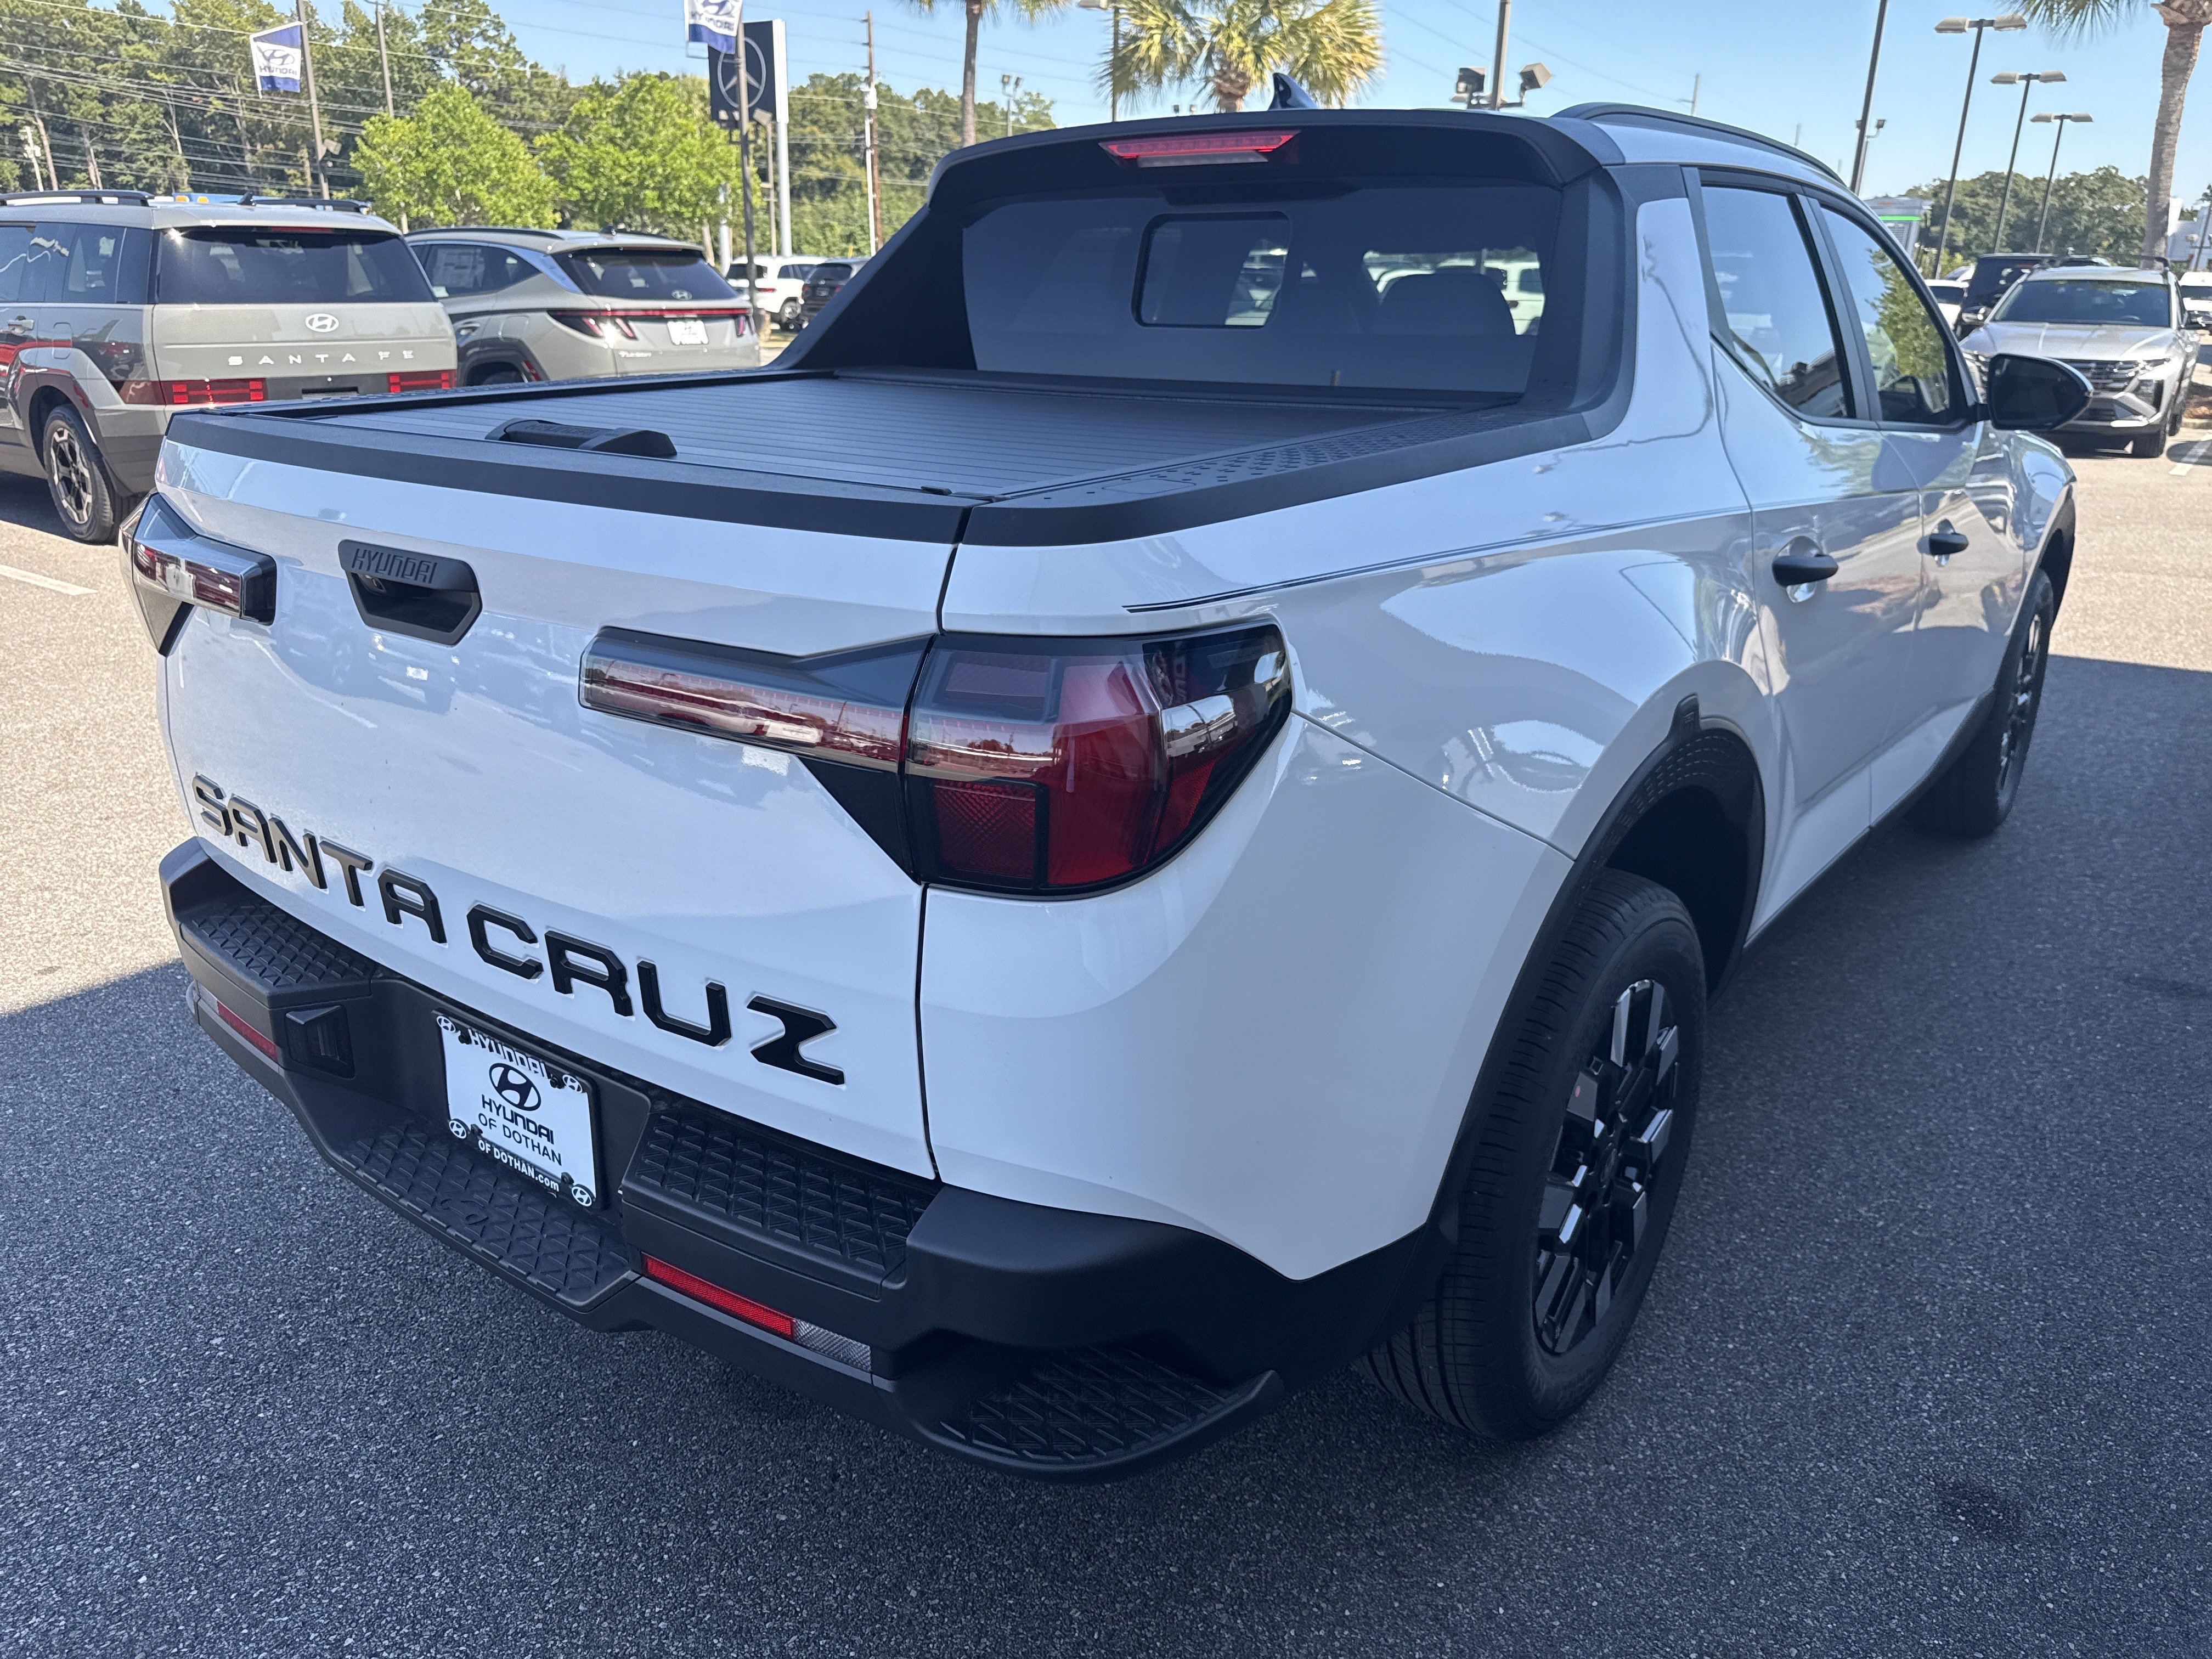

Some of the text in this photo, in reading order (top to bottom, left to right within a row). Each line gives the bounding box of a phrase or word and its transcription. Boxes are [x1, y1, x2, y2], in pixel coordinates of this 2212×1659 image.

[228, 349, 414, 366] SANTA FE
[351, 548, 438, 584] HYUNDAI
[192, 774, 847, 1087] SANTA CRUZ
[467, 1028, 549, 1078] HYUNDAI
[478, 1113, 562, 1166] OF DOTHAN
[482, 1094, 554, 1145] HYUNDAI
[478, 1139, 560, 1192] OF DOTHAN.com
